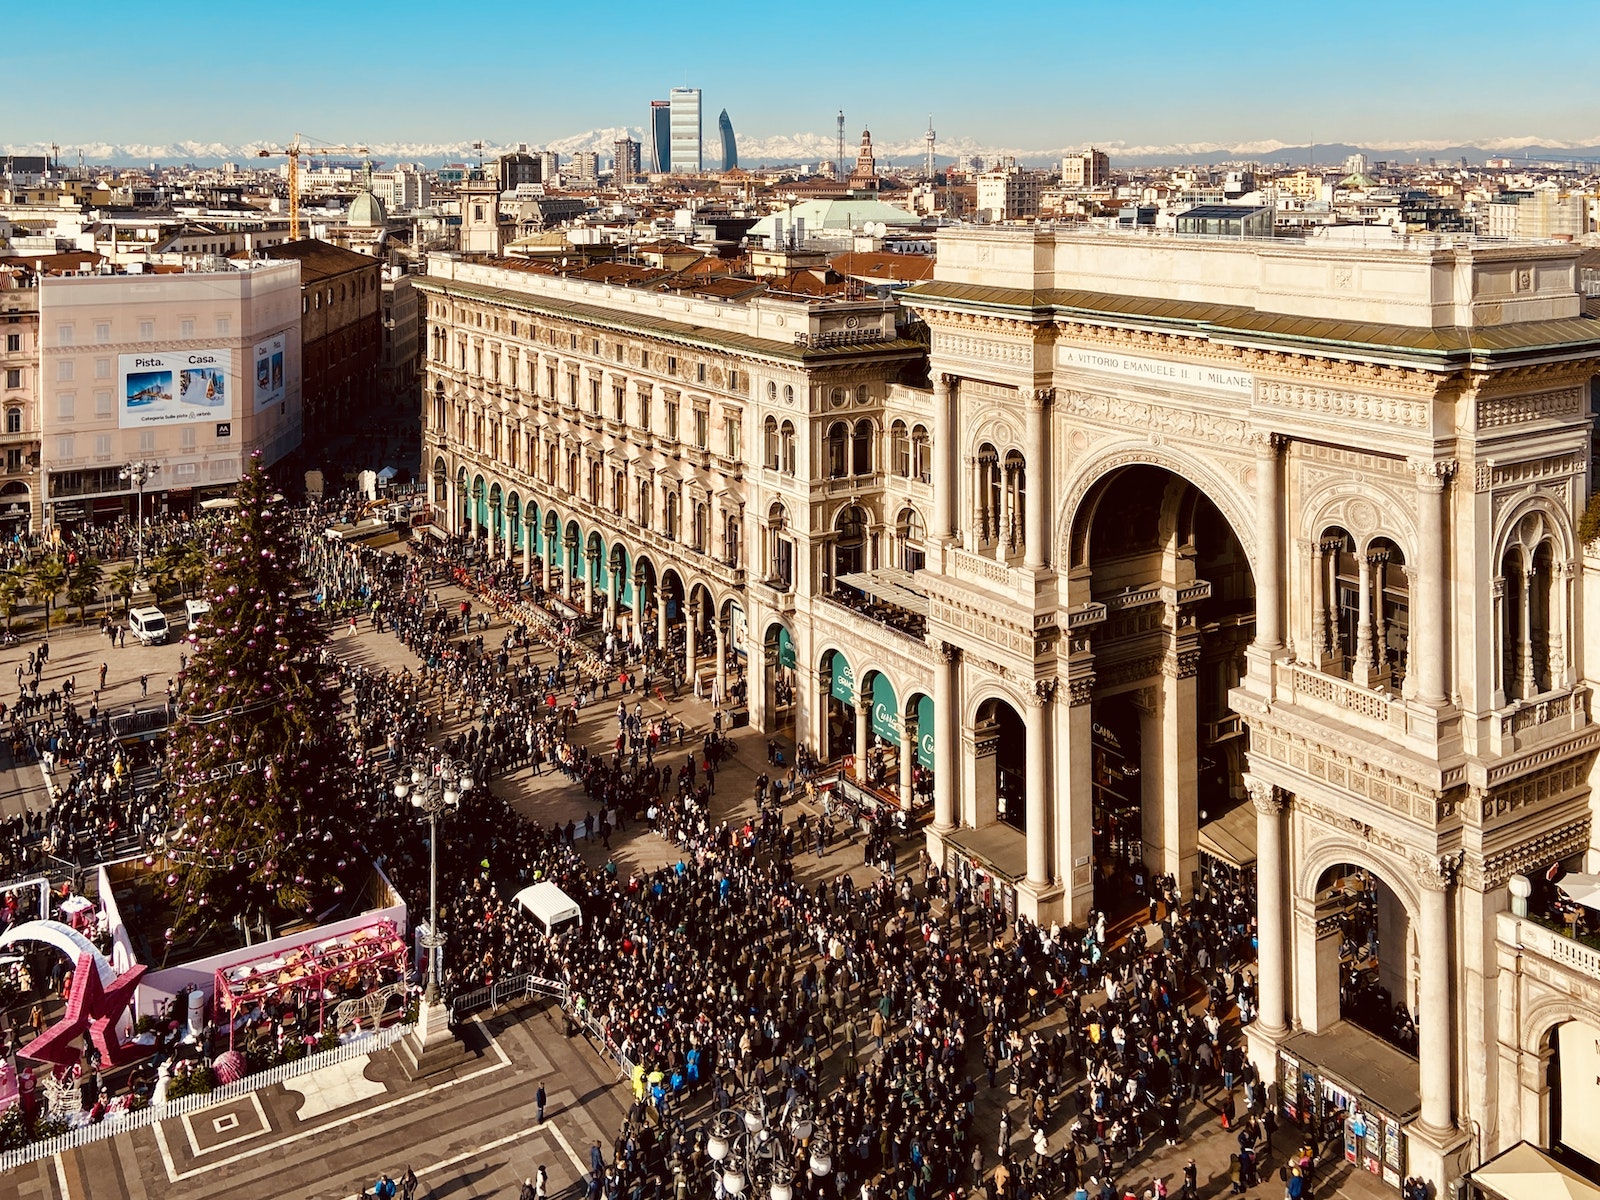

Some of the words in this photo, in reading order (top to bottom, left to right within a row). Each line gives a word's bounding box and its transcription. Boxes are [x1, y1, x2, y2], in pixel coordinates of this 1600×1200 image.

[135, 358, 164, 368] Pista.
[188, 355, 217, 364] Casa.
[1067, 353, 1073, 361] A
[1078, 355, 1119, 368] VITTORIO
[1123, 361, 1176, 377] EMANUELE
[1207, 373, 1252, 388] MILANES
[922, 734, 934, 754] Cu
[843, 758, 853, 767] M
